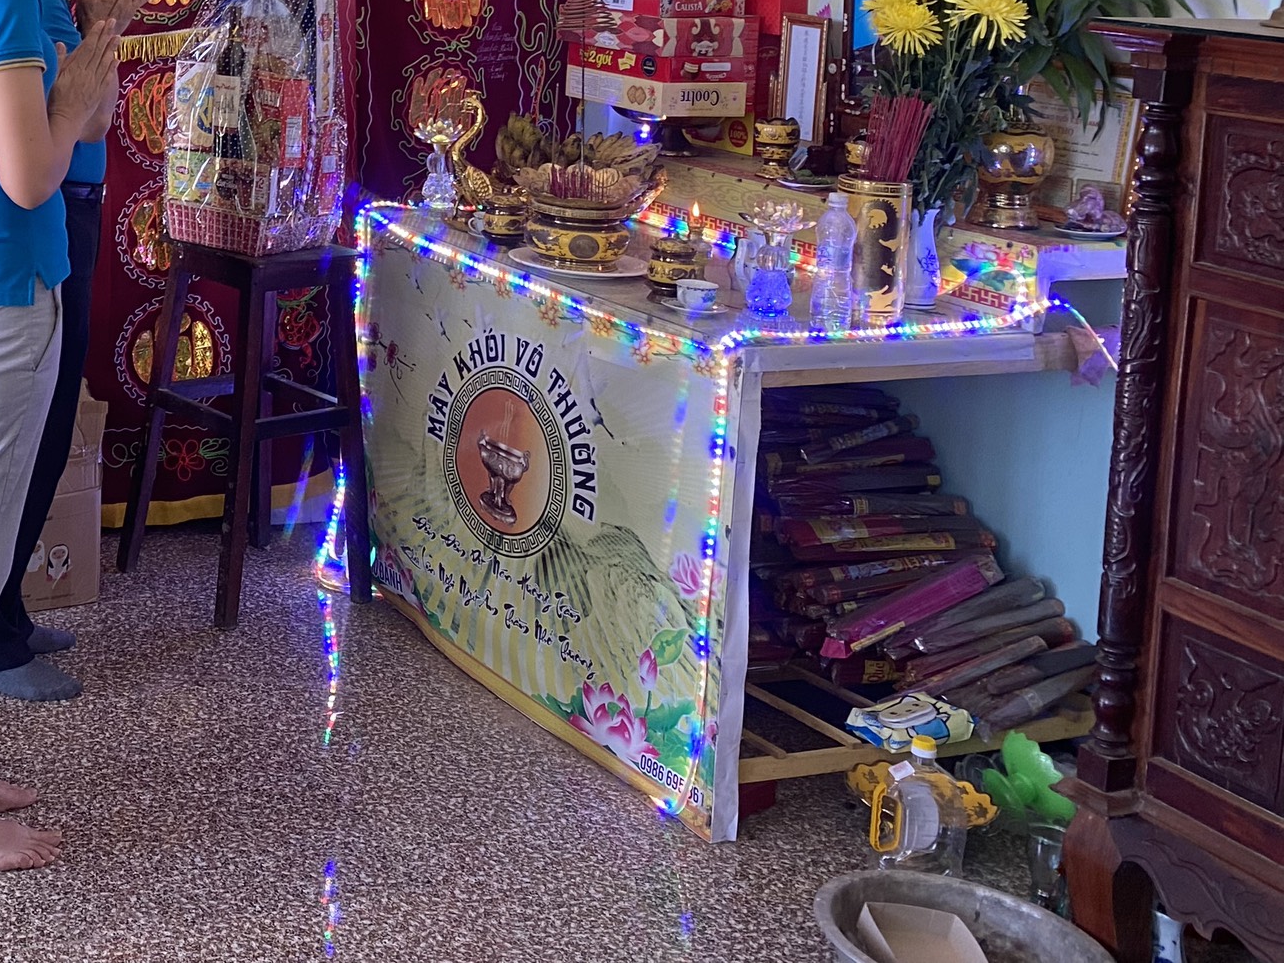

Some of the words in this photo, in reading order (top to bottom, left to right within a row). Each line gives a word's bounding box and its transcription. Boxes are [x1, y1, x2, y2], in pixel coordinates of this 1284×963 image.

[427, 372, 454, 442] MÂY
[514, 337, 544, 379] VÔ
[546, 367, 597, 523] THƯỜNG
[640, 754, 665, 782] 0986
